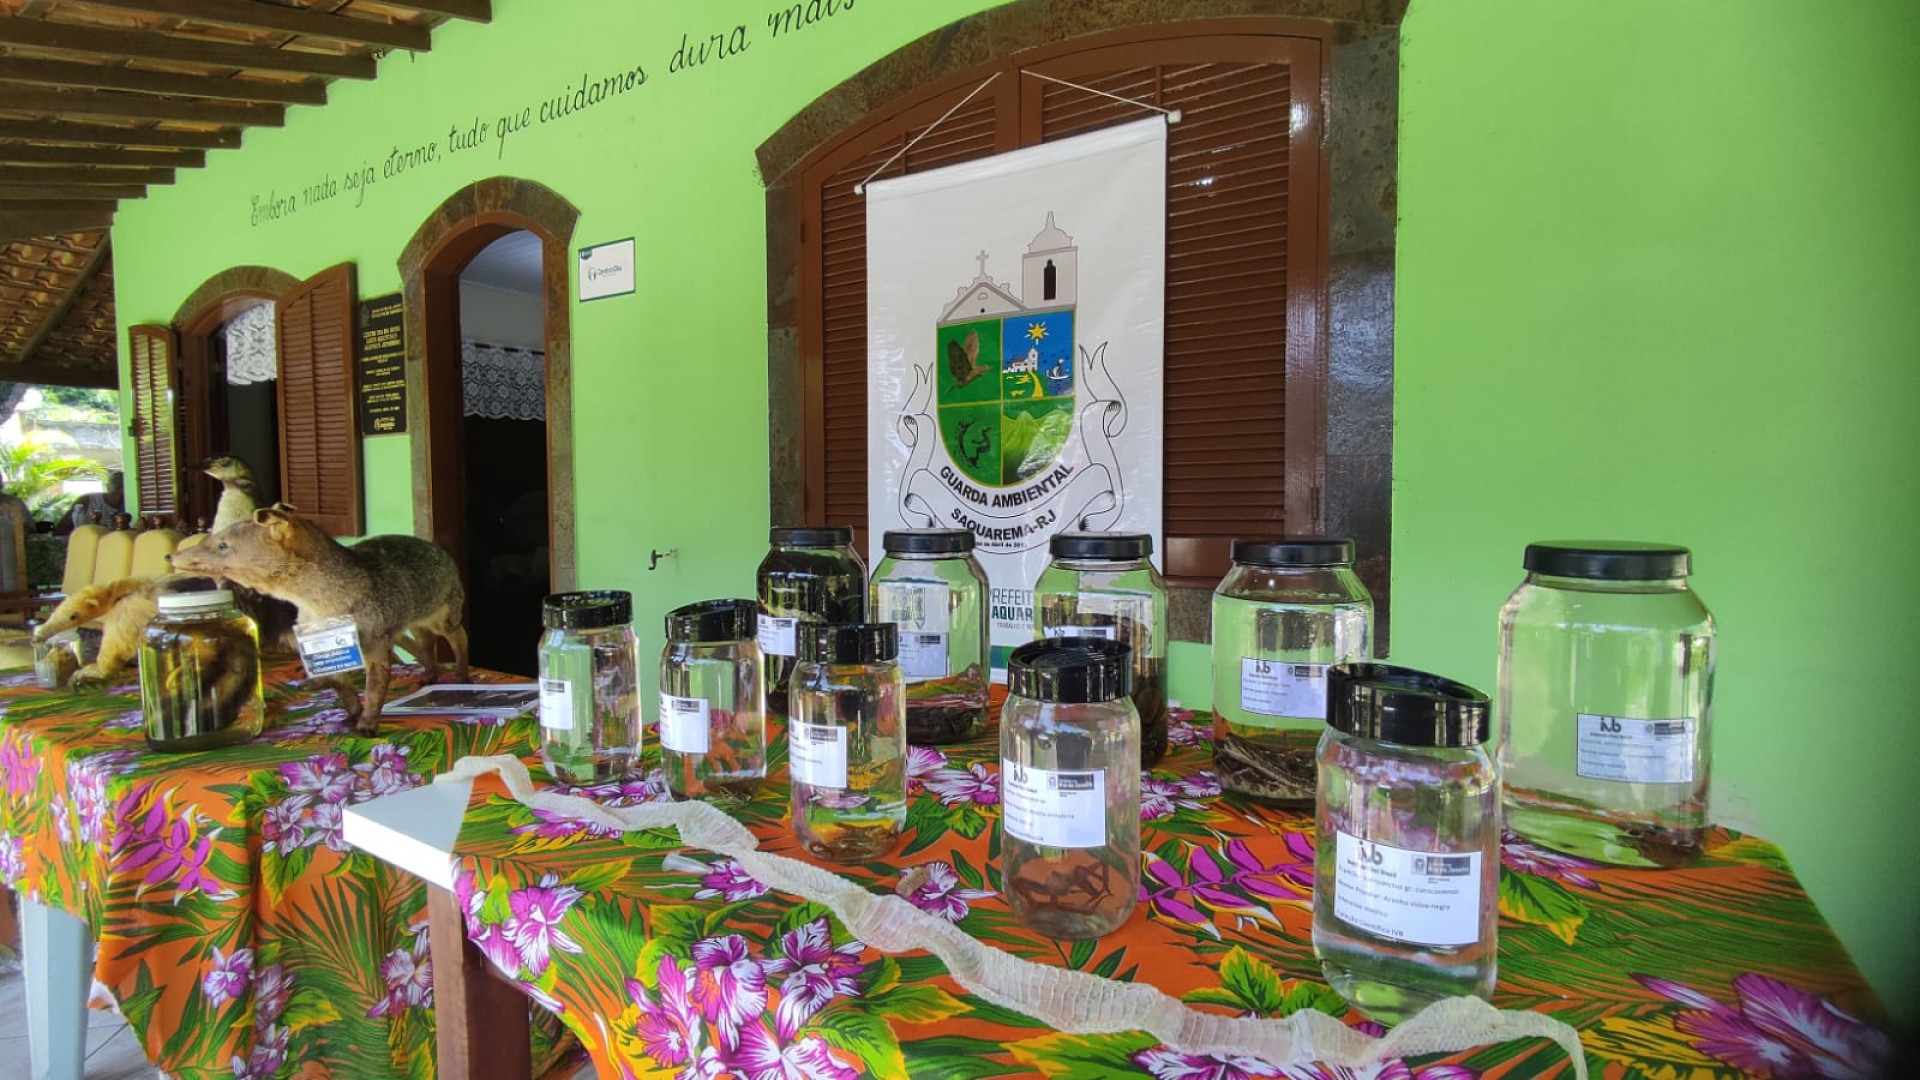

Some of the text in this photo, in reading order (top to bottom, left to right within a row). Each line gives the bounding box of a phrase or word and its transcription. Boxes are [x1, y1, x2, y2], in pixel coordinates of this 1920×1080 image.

[251, 189, 296, 226] Embora
[303, 173, 337, 206] nada
[343, 160, 375, 208] seja
[383, 145, 441, 180] eterno,
[449, 117, 489, 152] tudo
[496, 107, 530, 160] que
[539, 66, 648, 123] cuidamos
[669, 24, 751, 73] dura
[940, 464, 1075, 508] GUARDA AMBIENTAL
[951, 508, 1057, 541] SAQUAREMA-RJ
